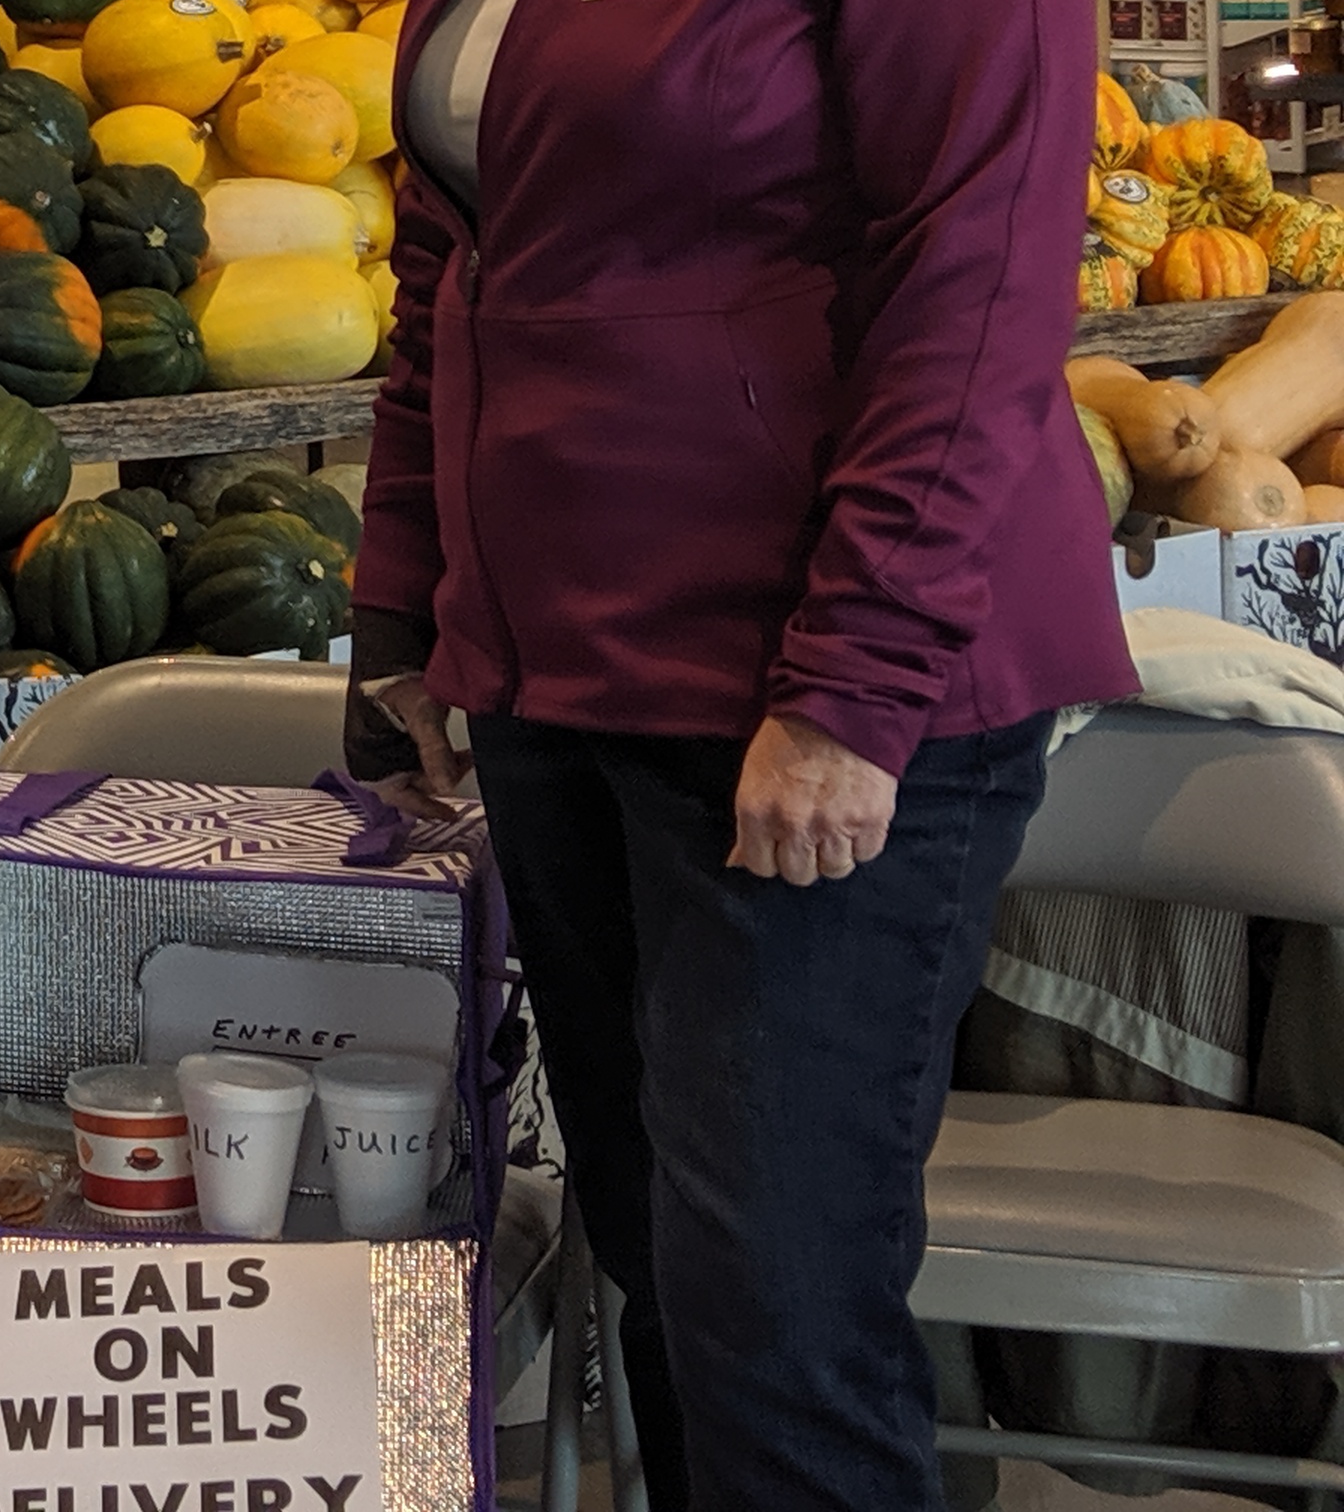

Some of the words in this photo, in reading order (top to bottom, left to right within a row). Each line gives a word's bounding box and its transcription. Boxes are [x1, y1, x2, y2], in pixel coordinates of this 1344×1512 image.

[14, 1257, 271, 1321] MEALS
[93, 1324, 216, 1382] ON
[0, 1384, 309, 1452] WHEELS
